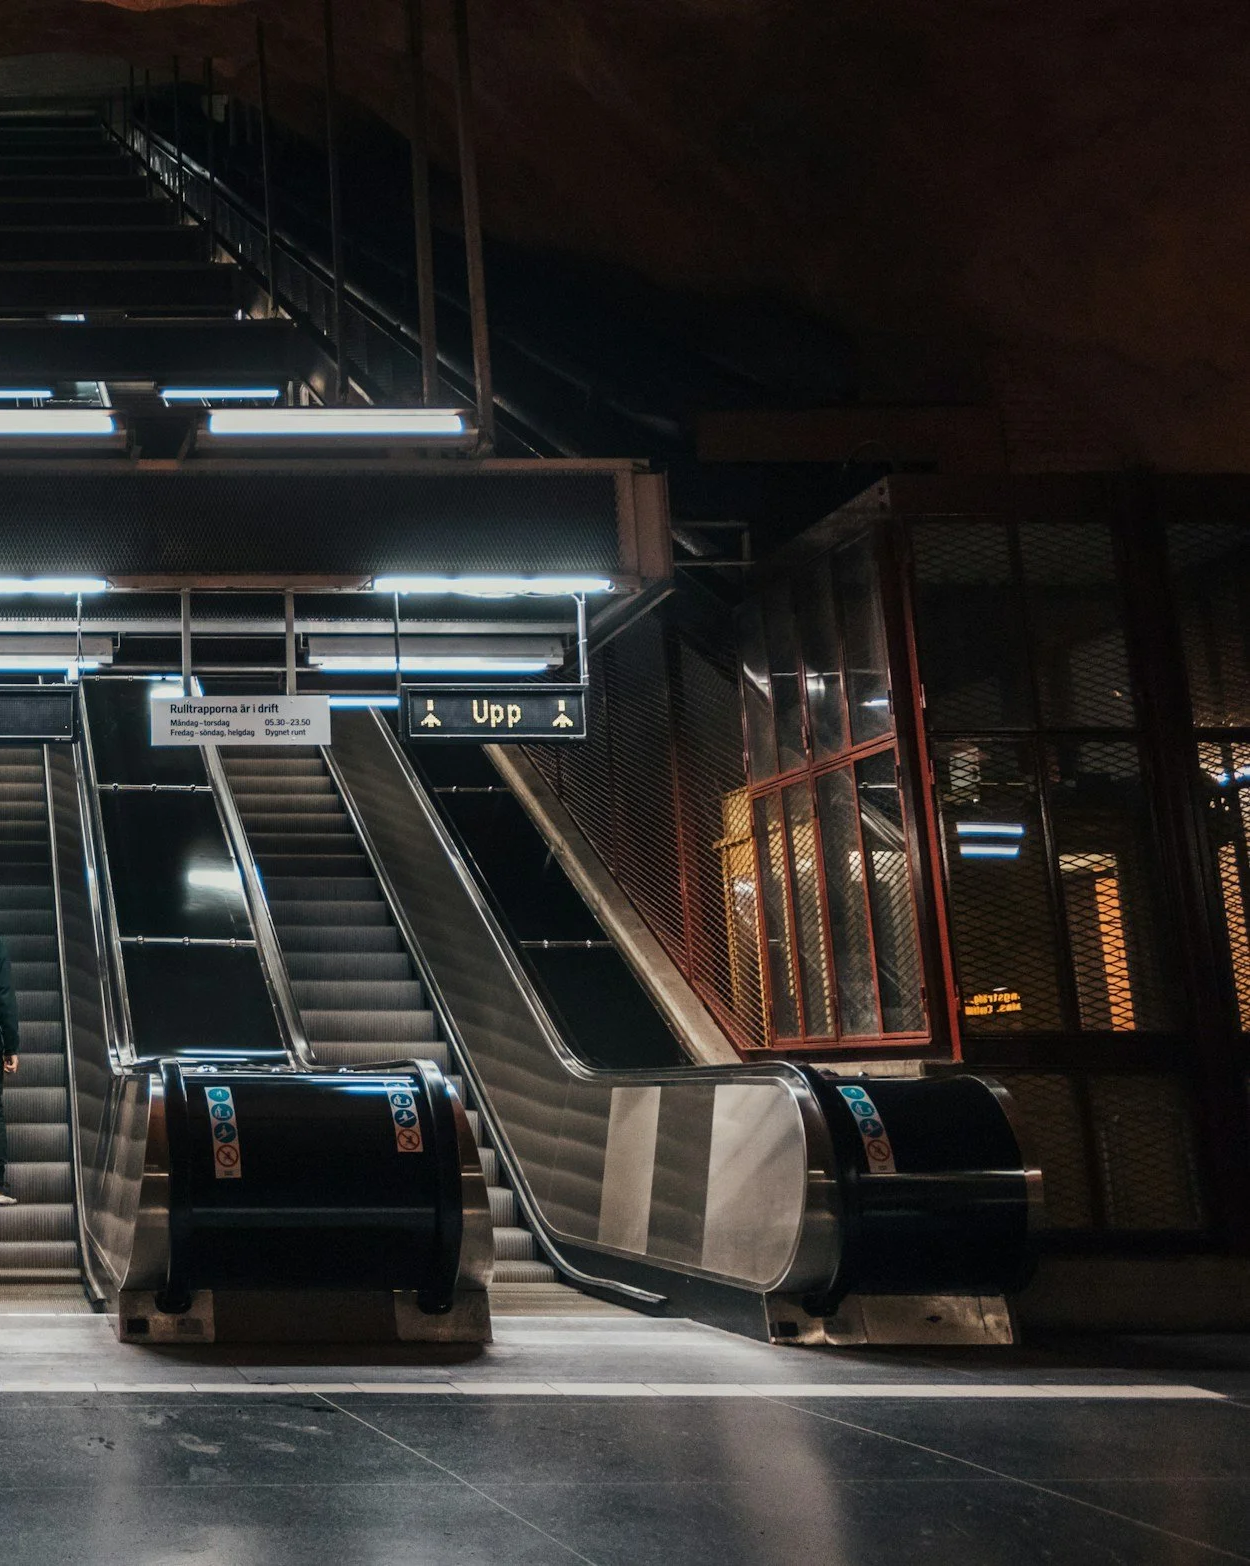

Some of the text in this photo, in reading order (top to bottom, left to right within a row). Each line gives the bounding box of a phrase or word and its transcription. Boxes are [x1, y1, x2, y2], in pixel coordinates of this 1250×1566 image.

[170, 704, 279, 715] Rulltrapporna är i drift
[472, 699, 522, 728] Upp
[228, 728, 255, 737] helgdag
[265, 729, 290, 737] Dygnet
